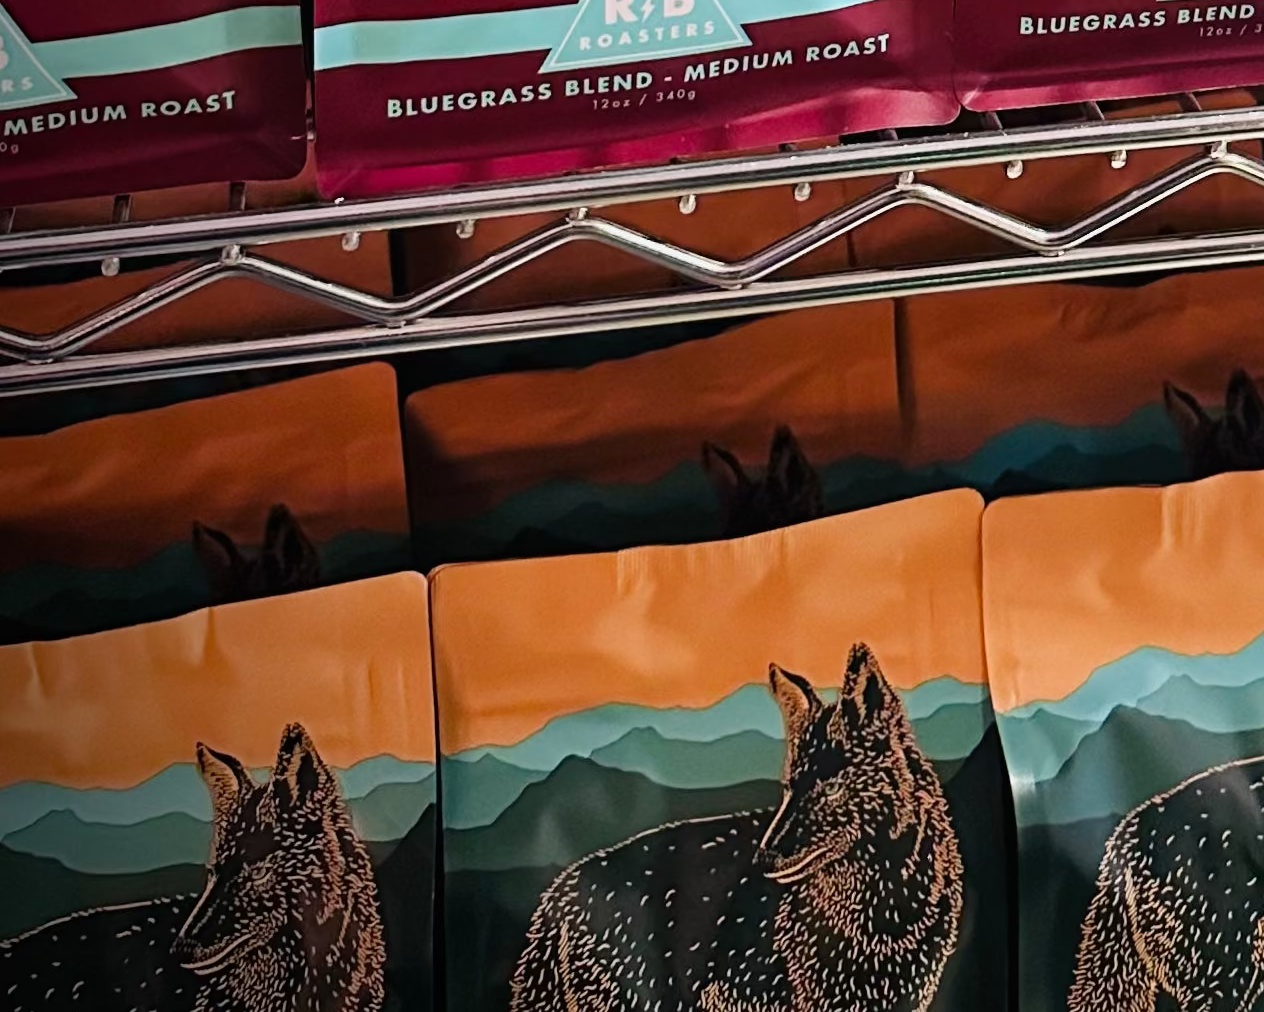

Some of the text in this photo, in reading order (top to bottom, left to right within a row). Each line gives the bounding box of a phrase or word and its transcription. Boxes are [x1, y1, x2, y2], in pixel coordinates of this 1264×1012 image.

[1020, 10, 1166, 35] BLUEGRASS
[1177, 4, 1255, 24] BLEND
[1200, 27, 1232, 37] 12oz
[579, 20, 715, 50] ROASTERS
[387, 83, 552, 118] BLUEGRASS
[565, 71, 653, 98] BLEND
[684, 50, 794, 82] MEDIUM
[806, 33, 891, 61] ROAST
[4, 90, 236, 136] MEDIUM ROAST
[593, 99, 630, 110] 12oz
[656, 89, 696, 101] 340g
[0, 141, 19, 154] 0g
